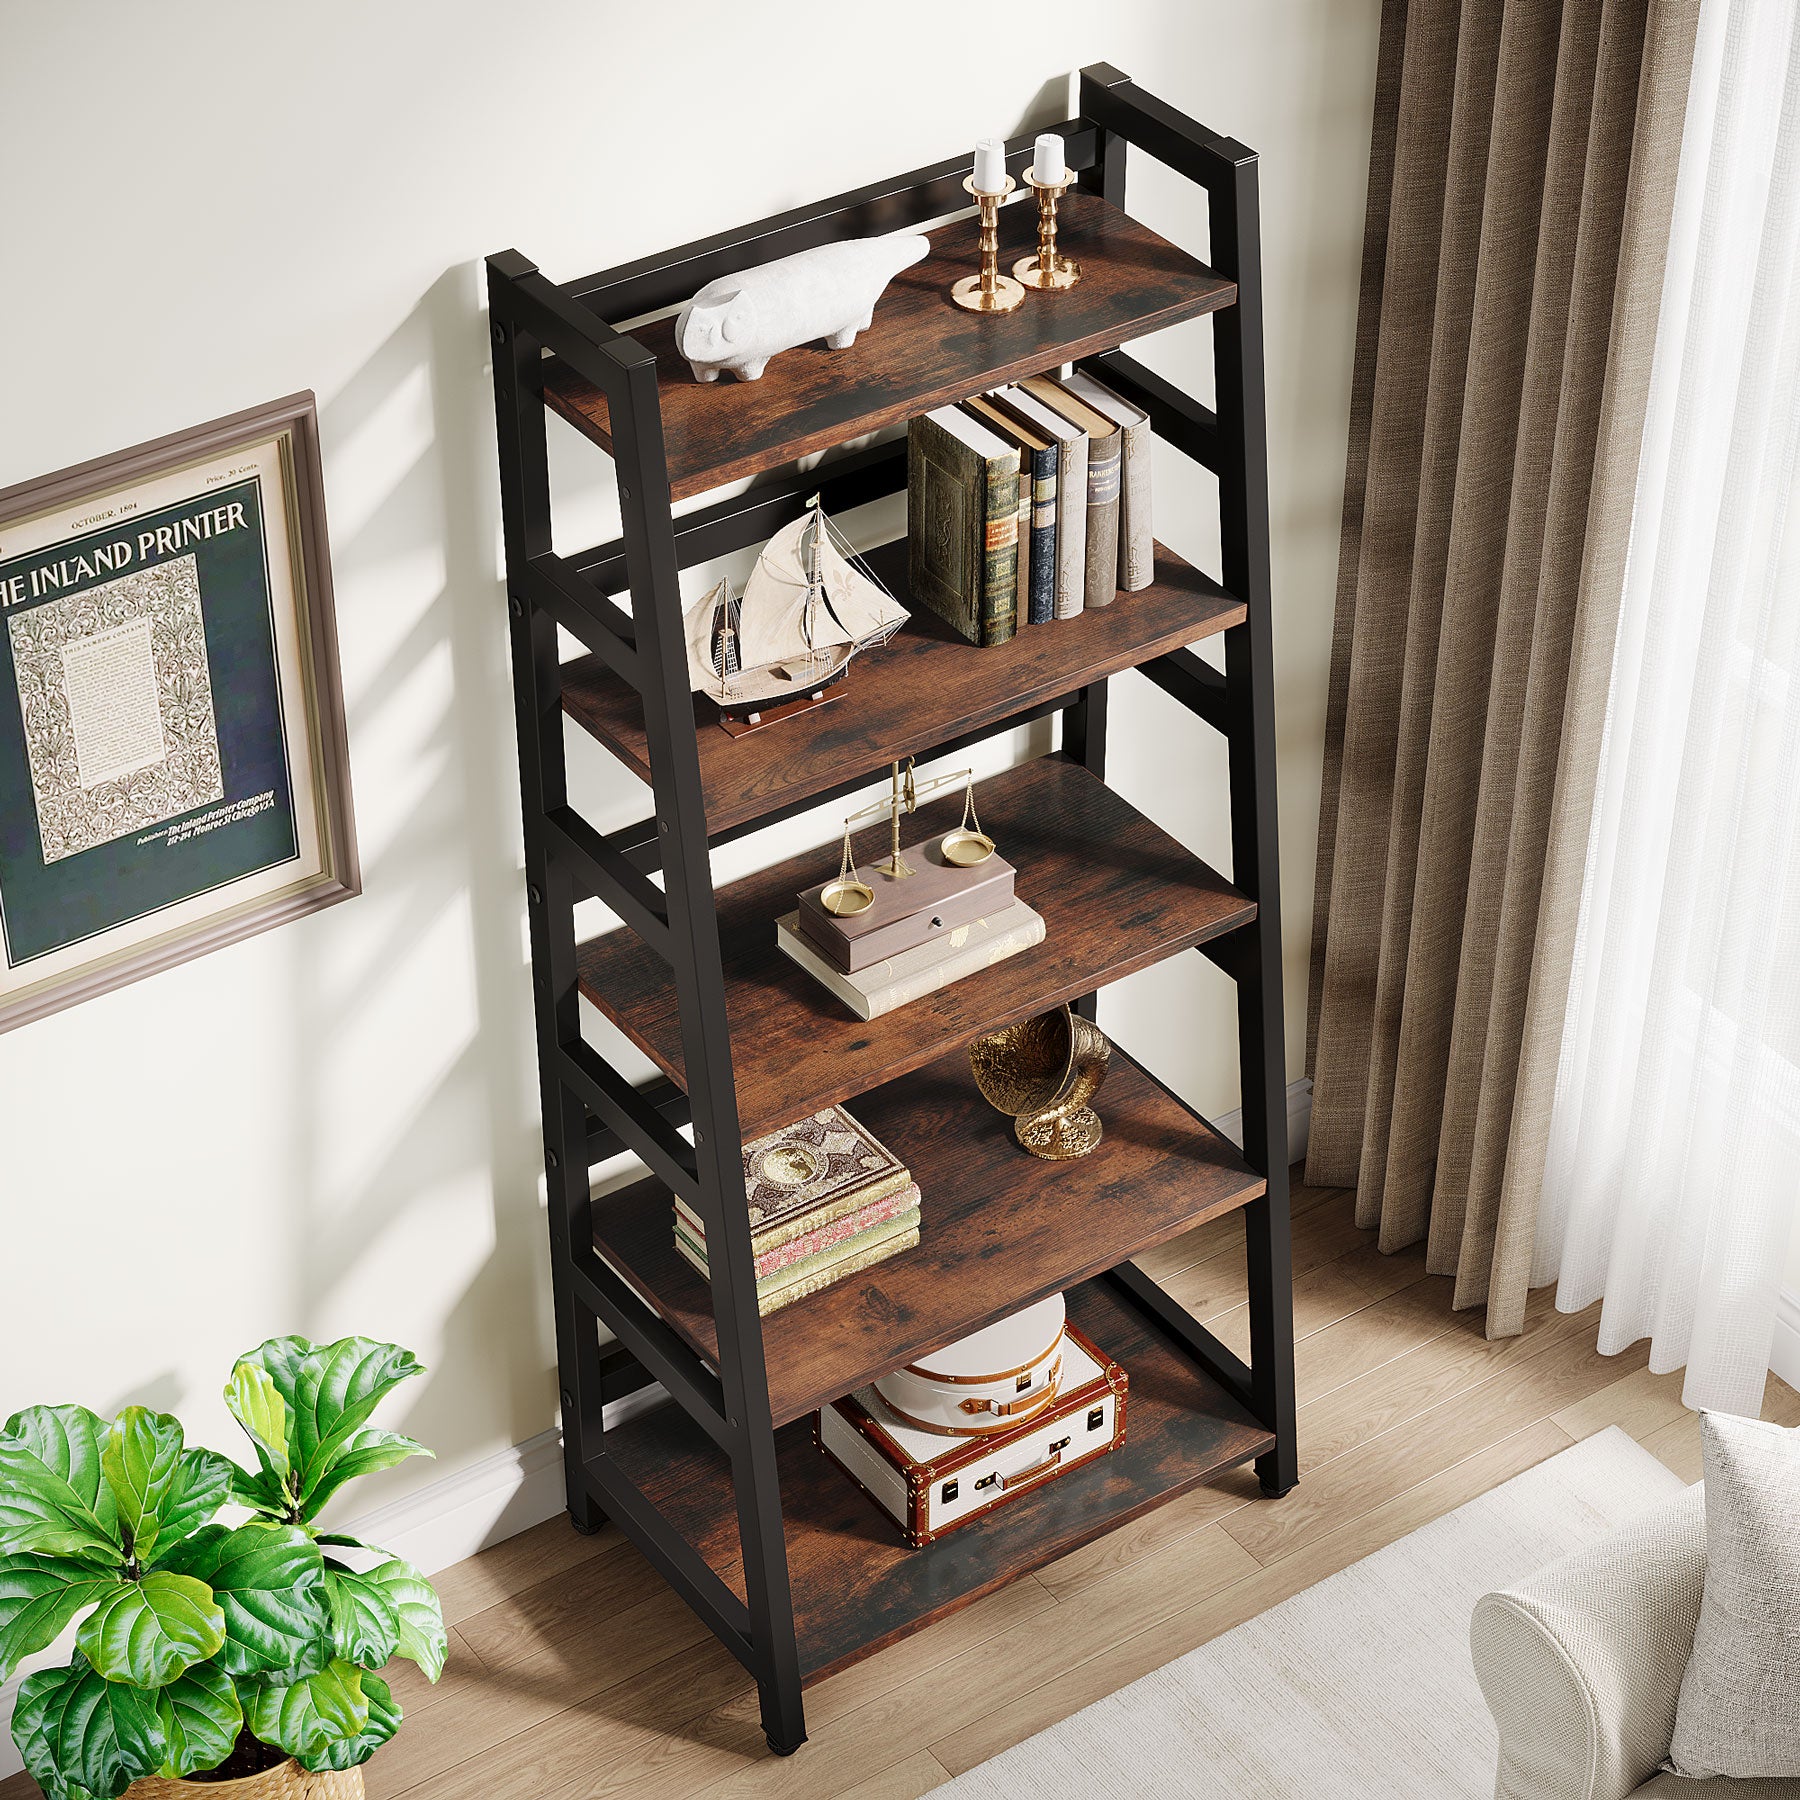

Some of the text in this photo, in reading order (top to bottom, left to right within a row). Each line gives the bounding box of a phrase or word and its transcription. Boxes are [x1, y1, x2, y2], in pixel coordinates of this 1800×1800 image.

[29, 541, 133, 598] INLAND
[137, 502, 249, 561] PRINTER
[181, 813, 208, 832] Inland
[207, 804, 237, 822] Printer
[237, 789, 275, 810] Company
